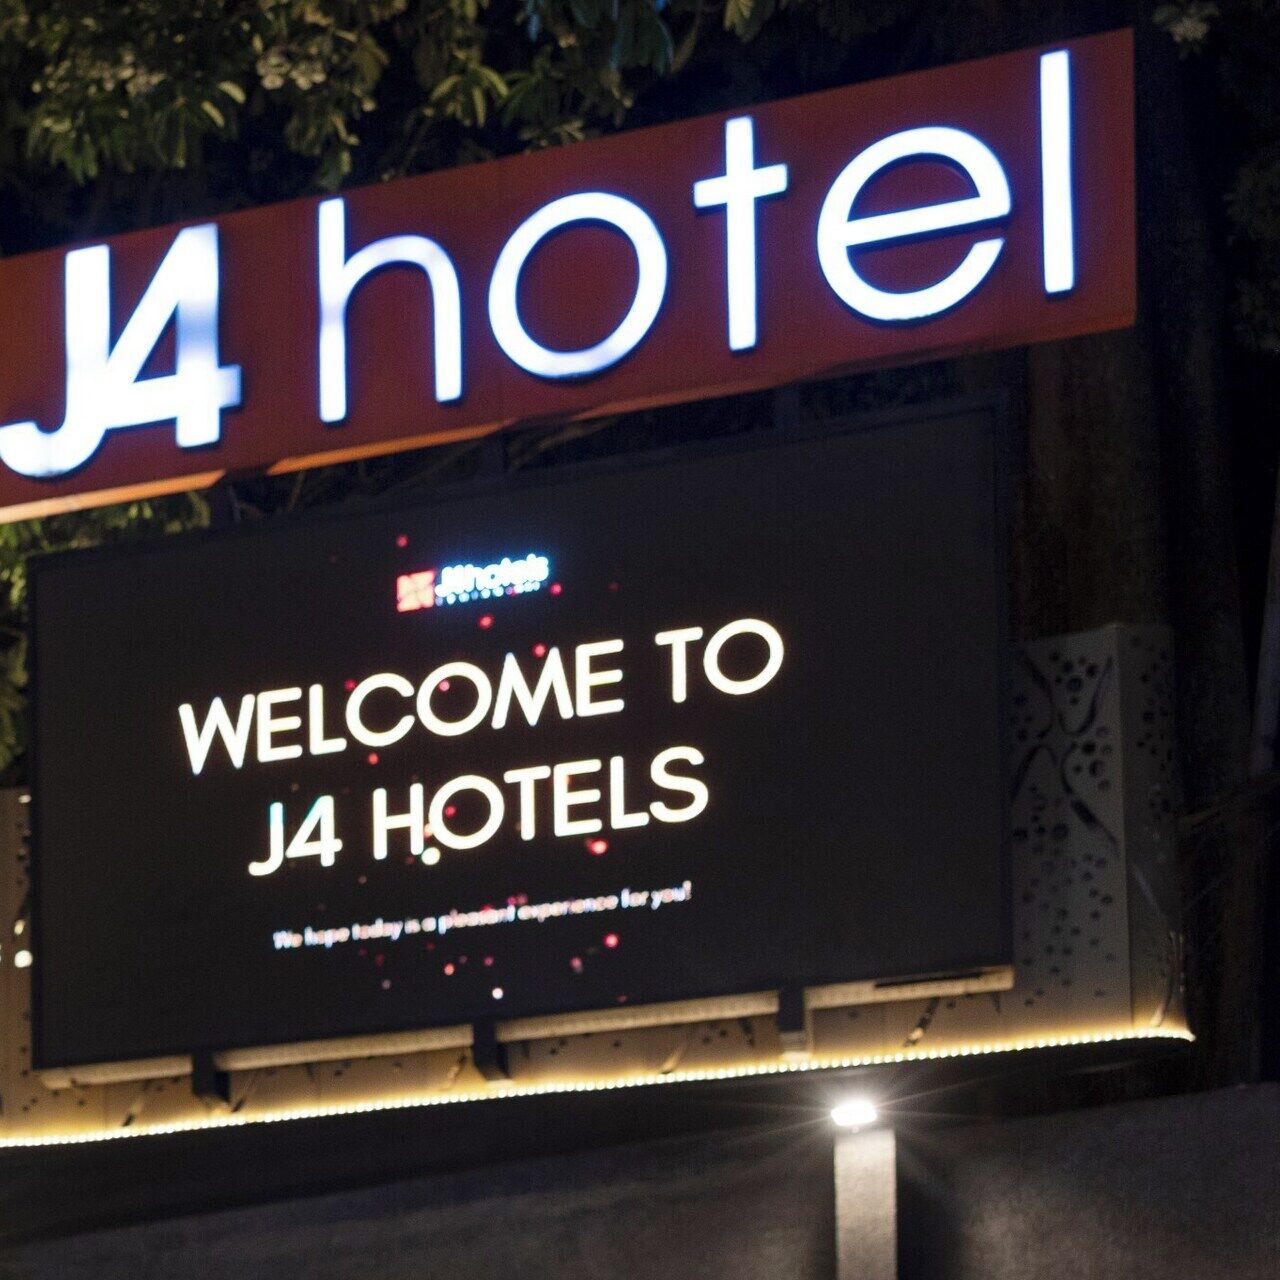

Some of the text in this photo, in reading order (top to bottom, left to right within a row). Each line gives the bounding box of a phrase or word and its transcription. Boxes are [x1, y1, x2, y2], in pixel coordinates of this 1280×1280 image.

[319, 51, 1073, 421] hotel
[179, 619, 784, 774] WELCOME TO
[249, 746, 708, 875] J4 HOTELS
[304, 926, 351, 949] hope
[351, 917, 403, 941] today
